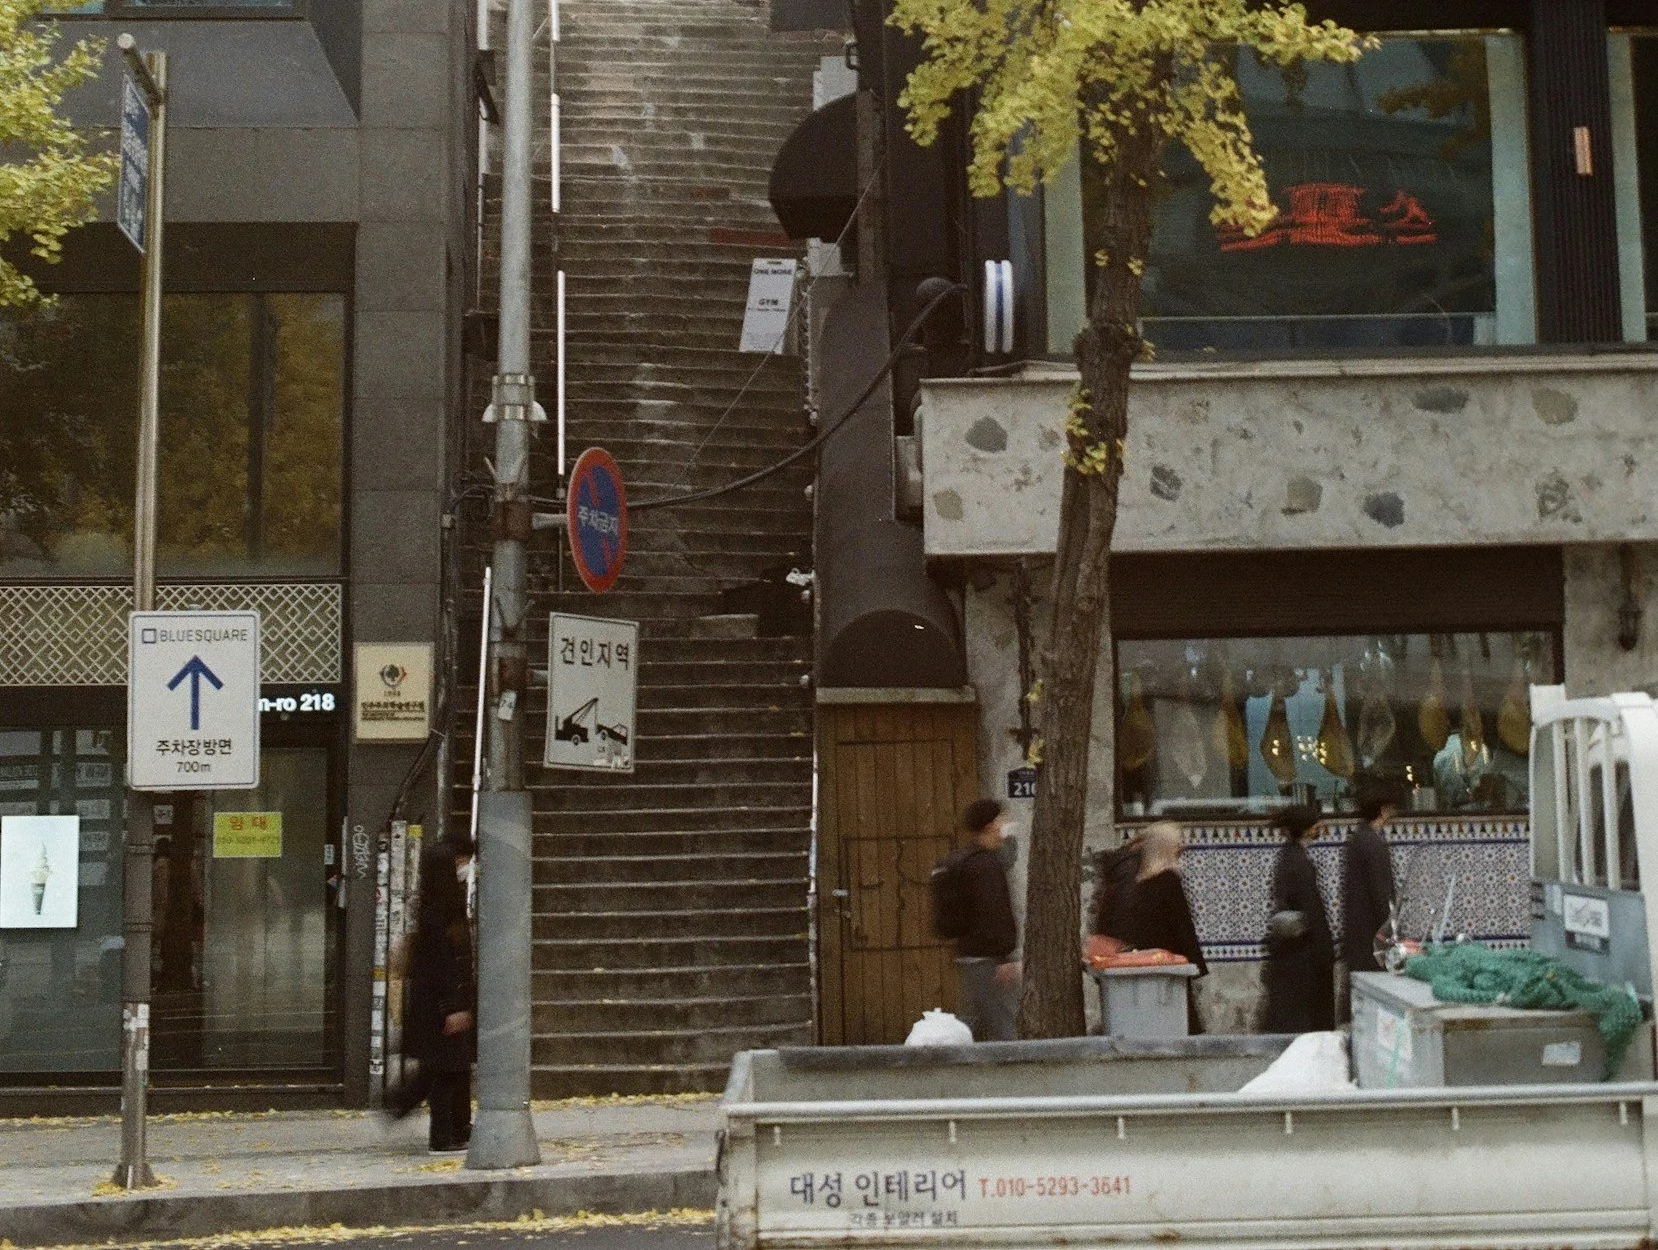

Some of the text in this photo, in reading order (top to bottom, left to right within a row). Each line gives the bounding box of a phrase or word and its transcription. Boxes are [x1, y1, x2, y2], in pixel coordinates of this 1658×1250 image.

[758, 298, 779, 306] GYM
[577, 505, 620, 536] 주차금지
[159, 628, 248, 643] BLUESQUARE
[561, 636, 629, 671] 견인지역
[299, 692, 336, 712] 218
[177, 761, 211, 773] 700m
[789, 1172, 842, 1208] 대성
[854, 1169, 967, 1208] 인테리어
